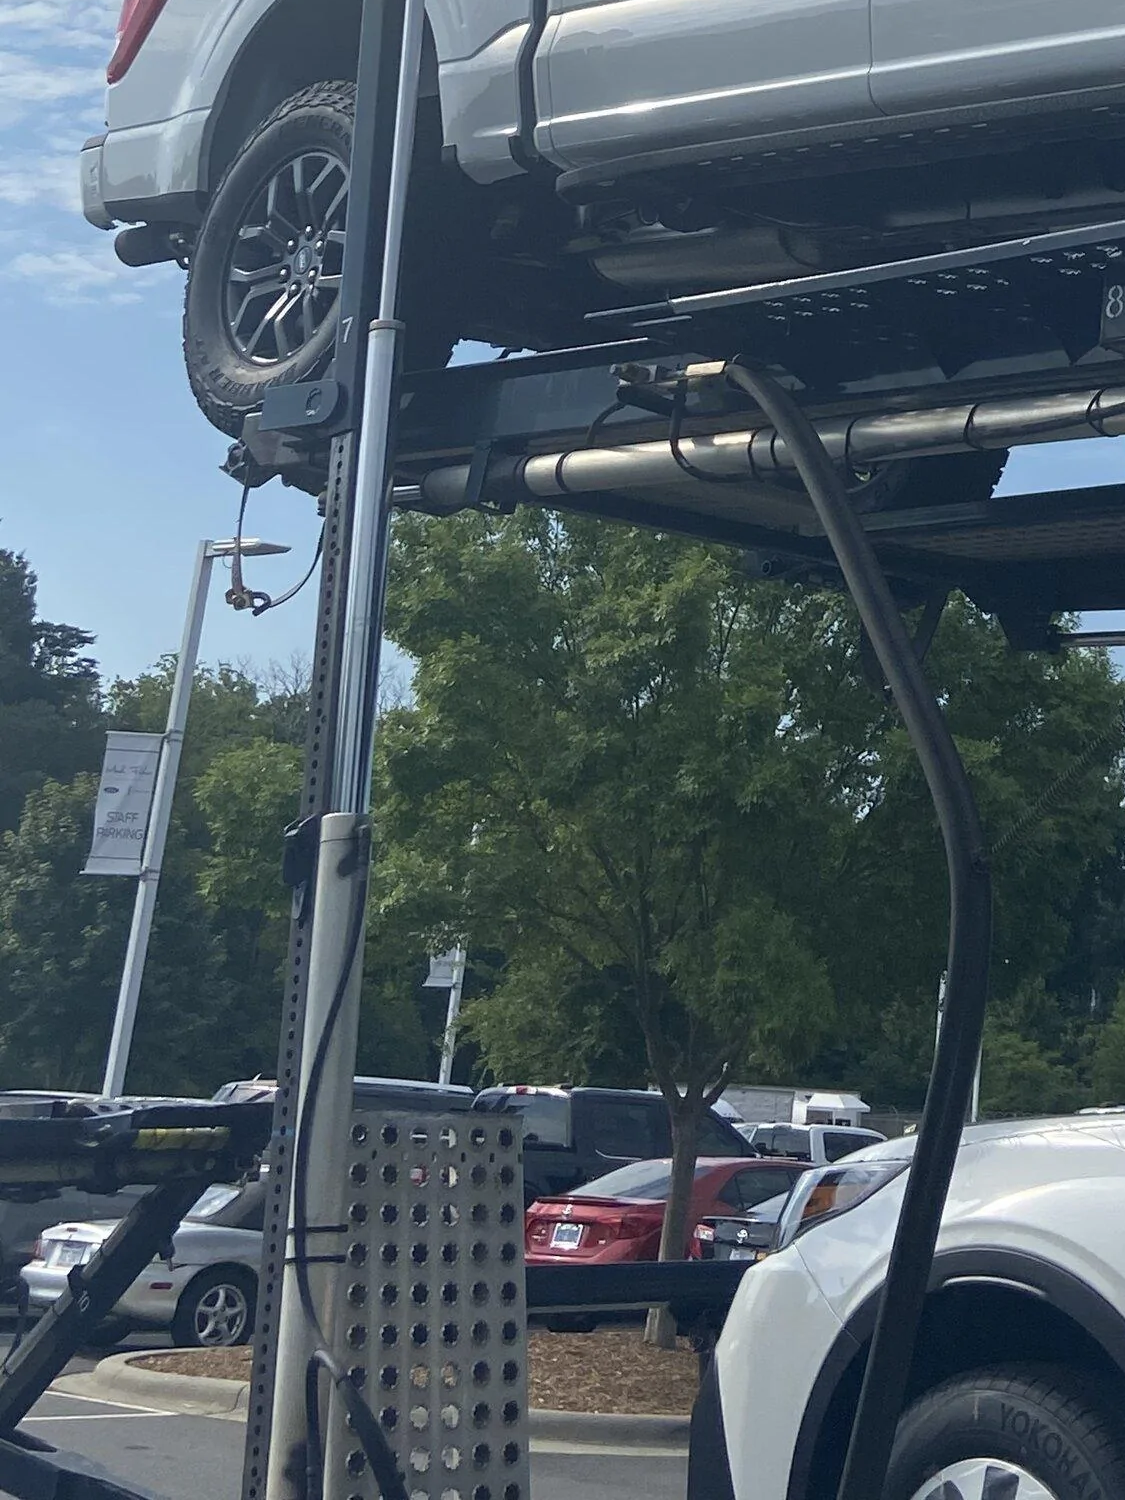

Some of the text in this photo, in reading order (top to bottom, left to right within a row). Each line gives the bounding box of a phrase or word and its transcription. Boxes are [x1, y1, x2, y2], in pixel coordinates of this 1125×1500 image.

[1105, 284, 1124, 319] 8
[106, 811, 140, 823] STAFF
[96, 826, 144, 840] PARKING
